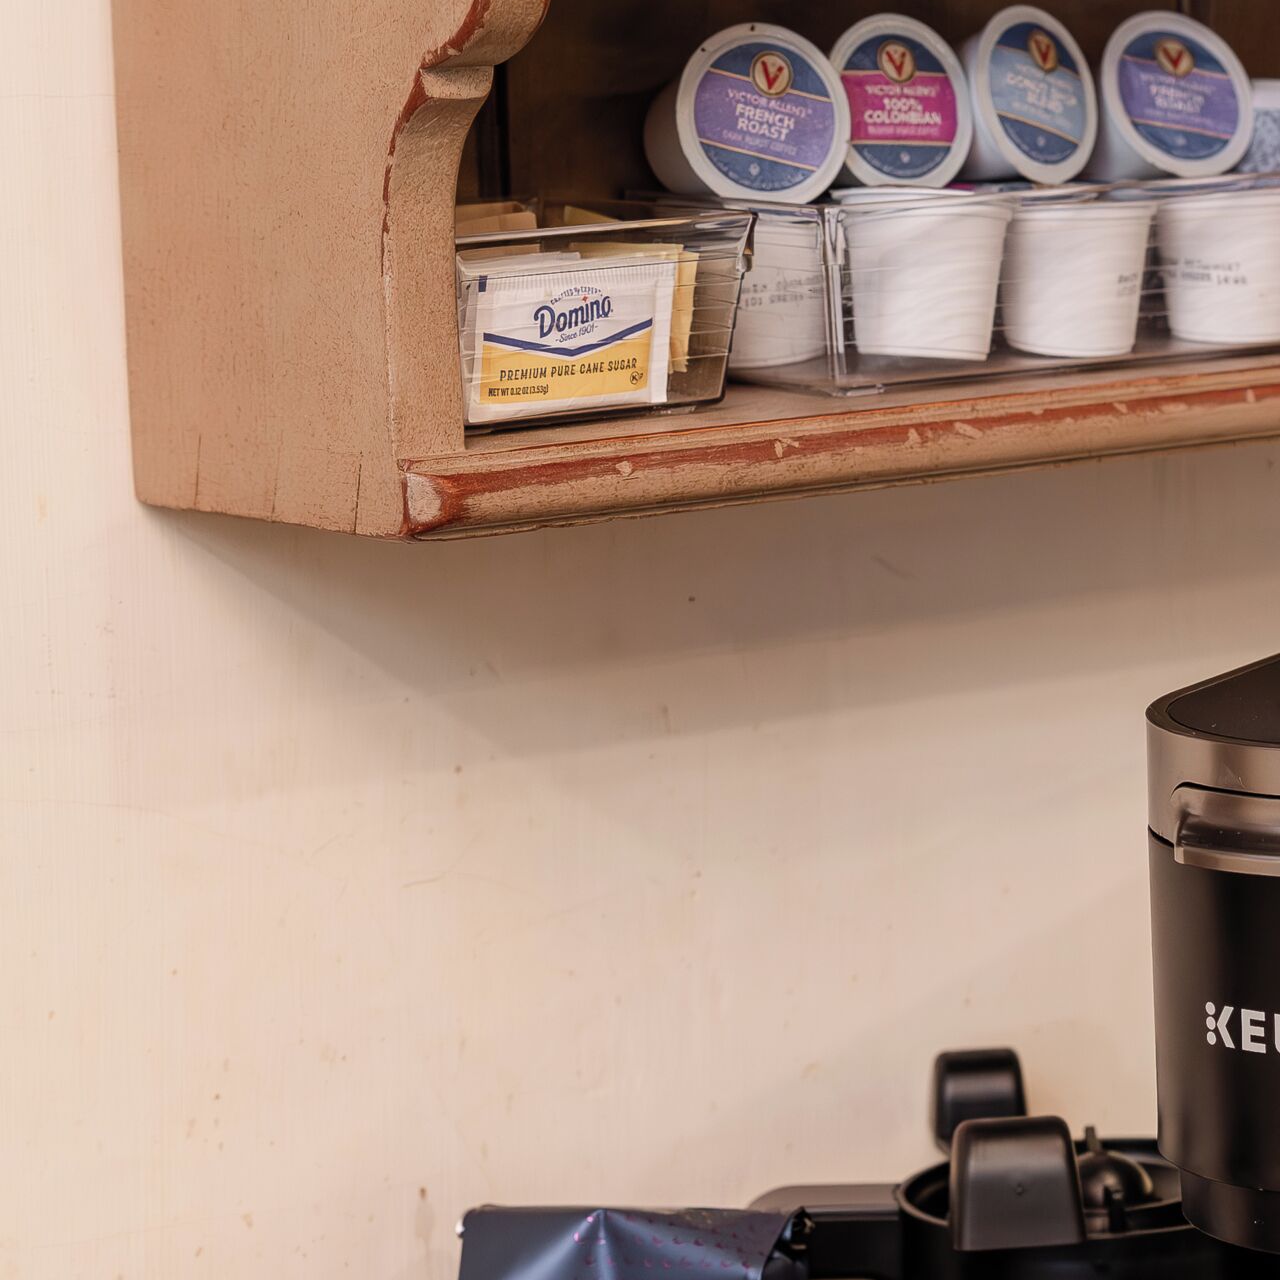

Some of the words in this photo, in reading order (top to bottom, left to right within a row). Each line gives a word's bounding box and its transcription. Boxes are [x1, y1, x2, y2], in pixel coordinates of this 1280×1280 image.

[760, 60, 785, 90] V
[886, 50, 907, 78] V
[735, 103, 795, 130] FRENCH
[737, 117, 790, 141] ROAST
[534, 296, 611, 338] Domino
[500, 368, 547, 381] PREMIUM
[551, 364, 576, 378] PURE
[580, 362, 604, 374] CANE
[607, 357, 637, 371] SUGAR
[488, 388, 499, 397] NET
[501, 387, 509, 396] WT
